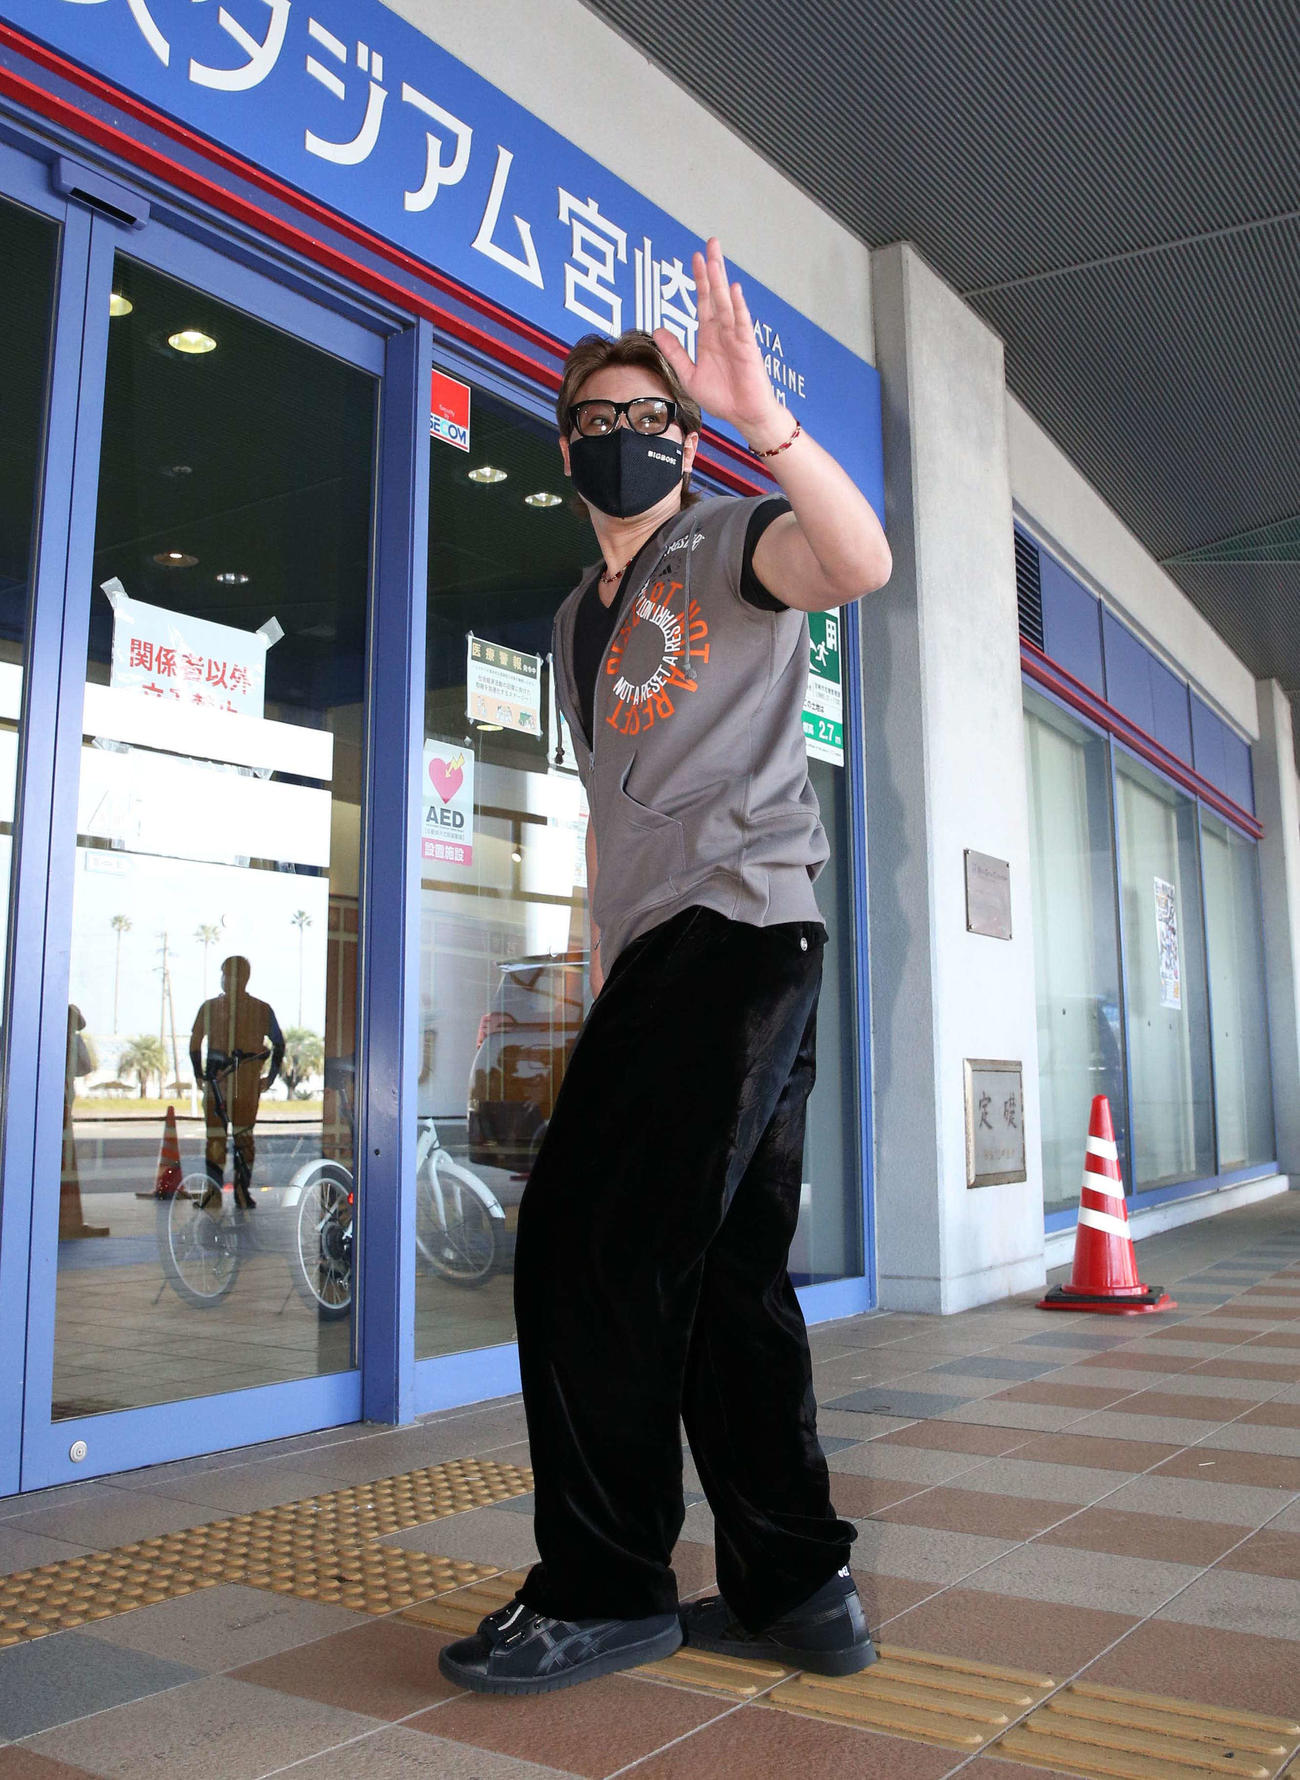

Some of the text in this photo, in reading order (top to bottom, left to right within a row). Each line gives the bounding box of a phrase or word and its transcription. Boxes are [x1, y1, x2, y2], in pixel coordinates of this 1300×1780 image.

[753, 319, 784, 358] ATA
[758, 347, 806, 399] ARINE
[647, 450, 677, 466] BIGBOSS
[640, 663, 671, 703] RESET
[426, 805, 465, 829] AED
